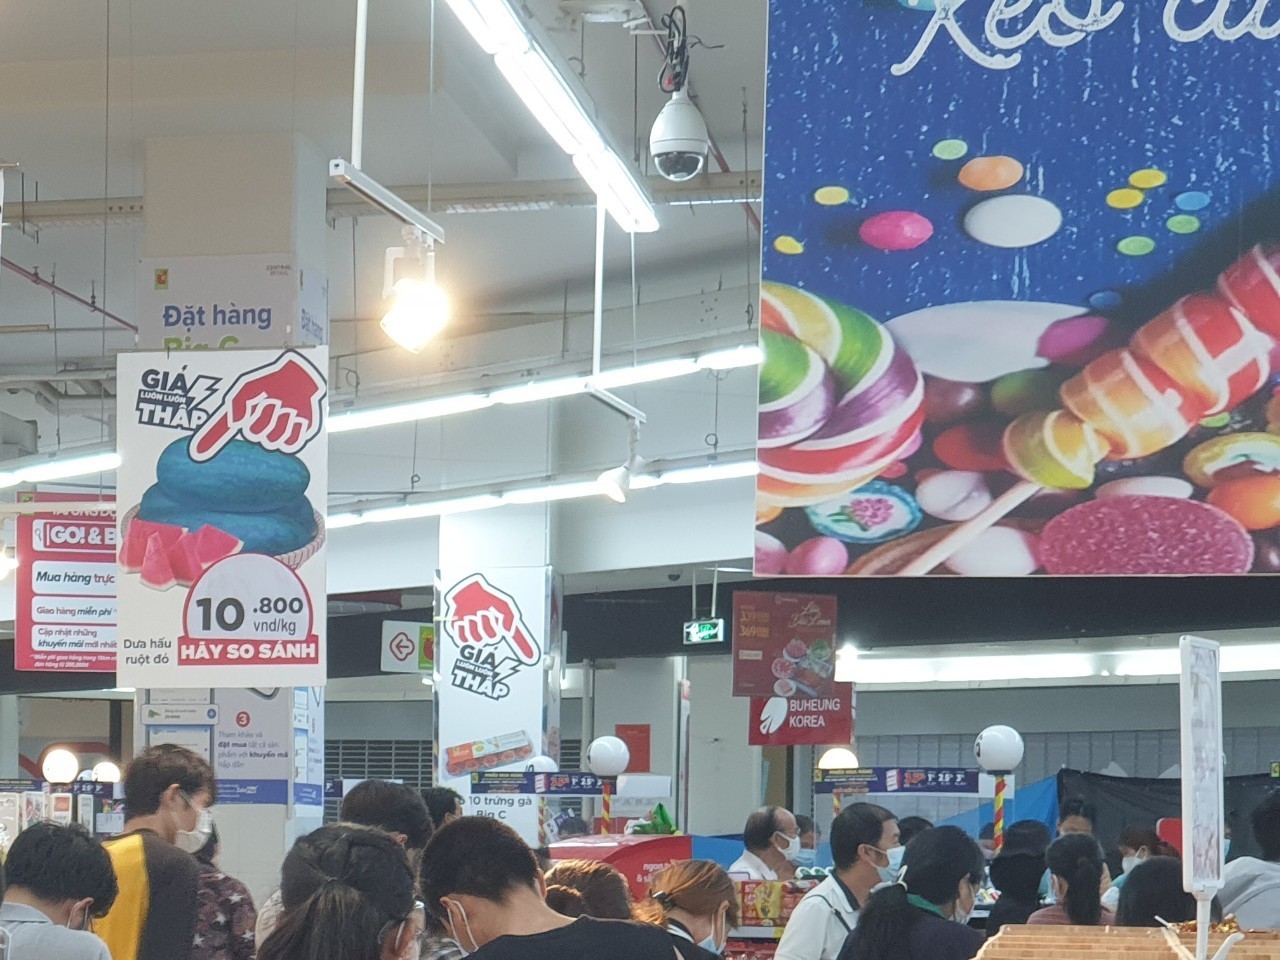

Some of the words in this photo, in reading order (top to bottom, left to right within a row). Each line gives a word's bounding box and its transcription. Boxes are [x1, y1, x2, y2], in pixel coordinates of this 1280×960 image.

[162, 304, 206, 333] Đặt
[212, 302, 272, 330] hàng
[141, 365, 189, 396] GIÁ
[141, 391, 163, 400] LUÔN
[164, 393, 186, 403] LUÔN
[50, 525, 85, 545] GO!
[88, 527, 102, 545] &
[36, 571, 61, 582] Mua
[63, 571, 91, 585] hàng
[94, 573, 115, 586] trực
[37, 606, 54, 615] Giao
[56, 605, 76, 617] hàng
[77, 605, 97, 616] miễn
[98, 607, 112, 619] phí
[252, 597, 304, 615] .800
[196, 598, 245, 632] 10
[253, 618, 297, 636] vnd/kg
[38, 639, 67, 650] khuyến
[124, 639, 146, 649] Dưa
[150, 637, 172, 649] hấu
[181, 641, 222, 660] HÃY
[227, 644, 255, 659] SO
[258, 640, 317, 659] SÁNH
[126, 653, 149, 666] ruột
[153, 652, 169, 664] đỏ
[460, 645, 498, 670] GIÁ
[789, 698, 840, 712] BUHEUNG
[238, 714, 247, 725] 3
[789, 715, 825, 728] KOREA
[469, 796, 481, 806] 10
[484, 795, 514, 807] trứng
[518, 796, 533, 808] gà
